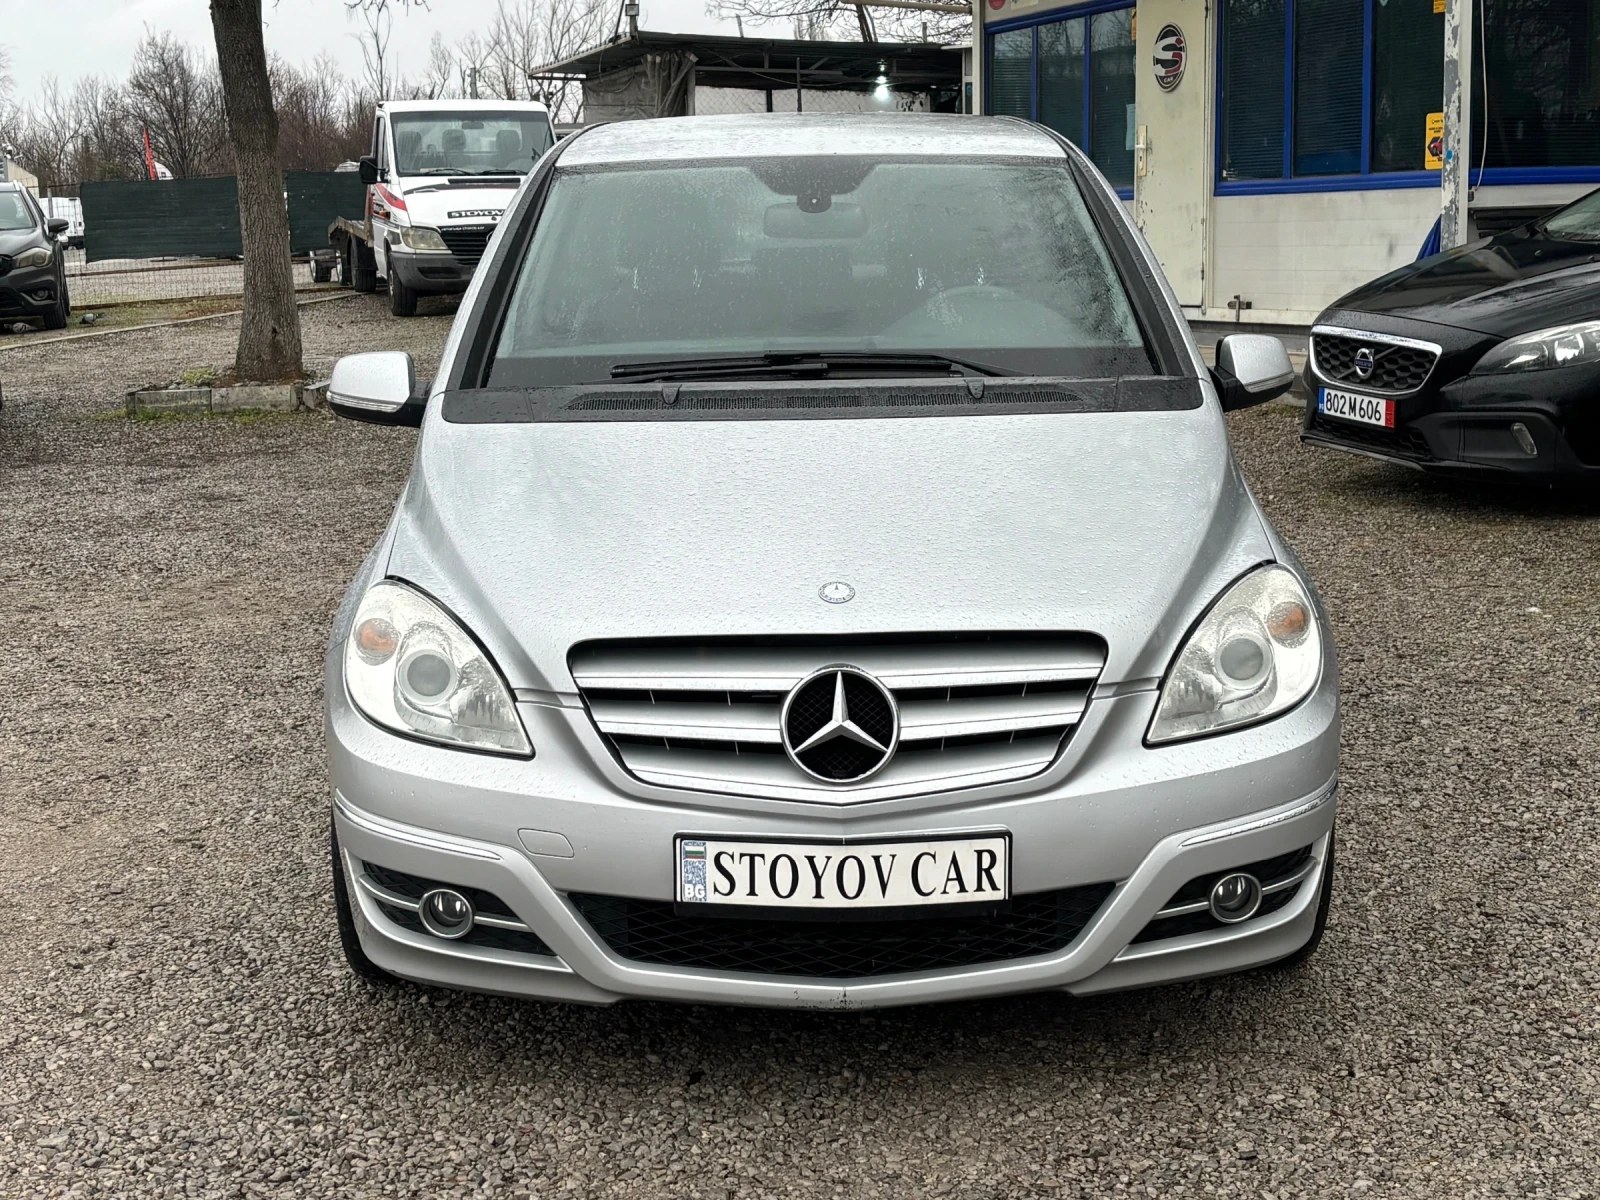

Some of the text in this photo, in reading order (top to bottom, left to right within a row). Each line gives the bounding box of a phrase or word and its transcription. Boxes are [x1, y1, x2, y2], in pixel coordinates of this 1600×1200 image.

[684, 883, 706, 898] BG
[713, 848, 1001, 900] STOYOV CAR
